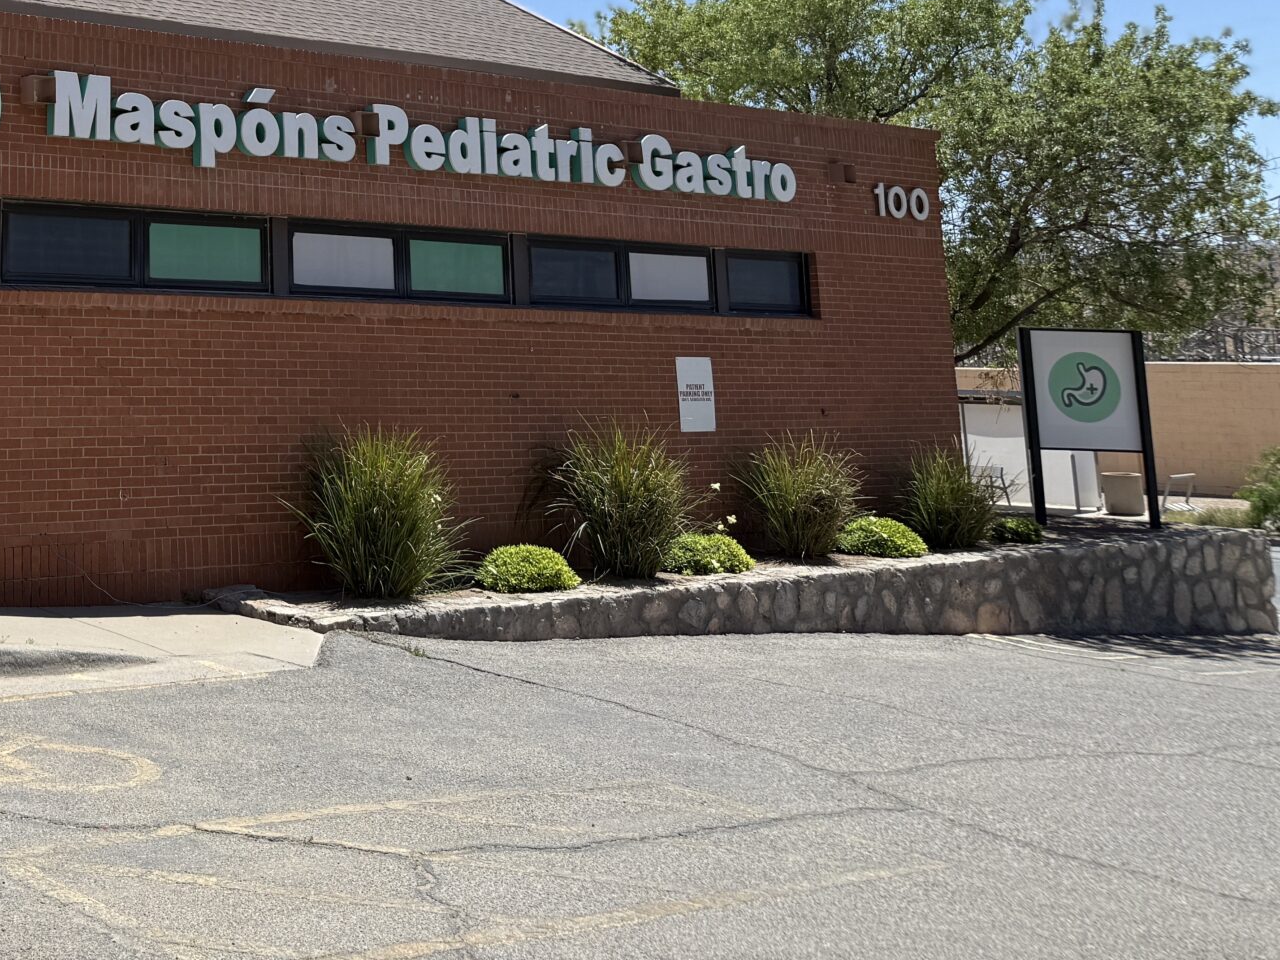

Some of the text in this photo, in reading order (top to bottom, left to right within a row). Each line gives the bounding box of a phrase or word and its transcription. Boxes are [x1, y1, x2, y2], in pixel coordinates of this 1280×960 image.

[51, 69, 797, 204] Maspóns Pediatric Gastro
[873, 183, 930, 221] 100
